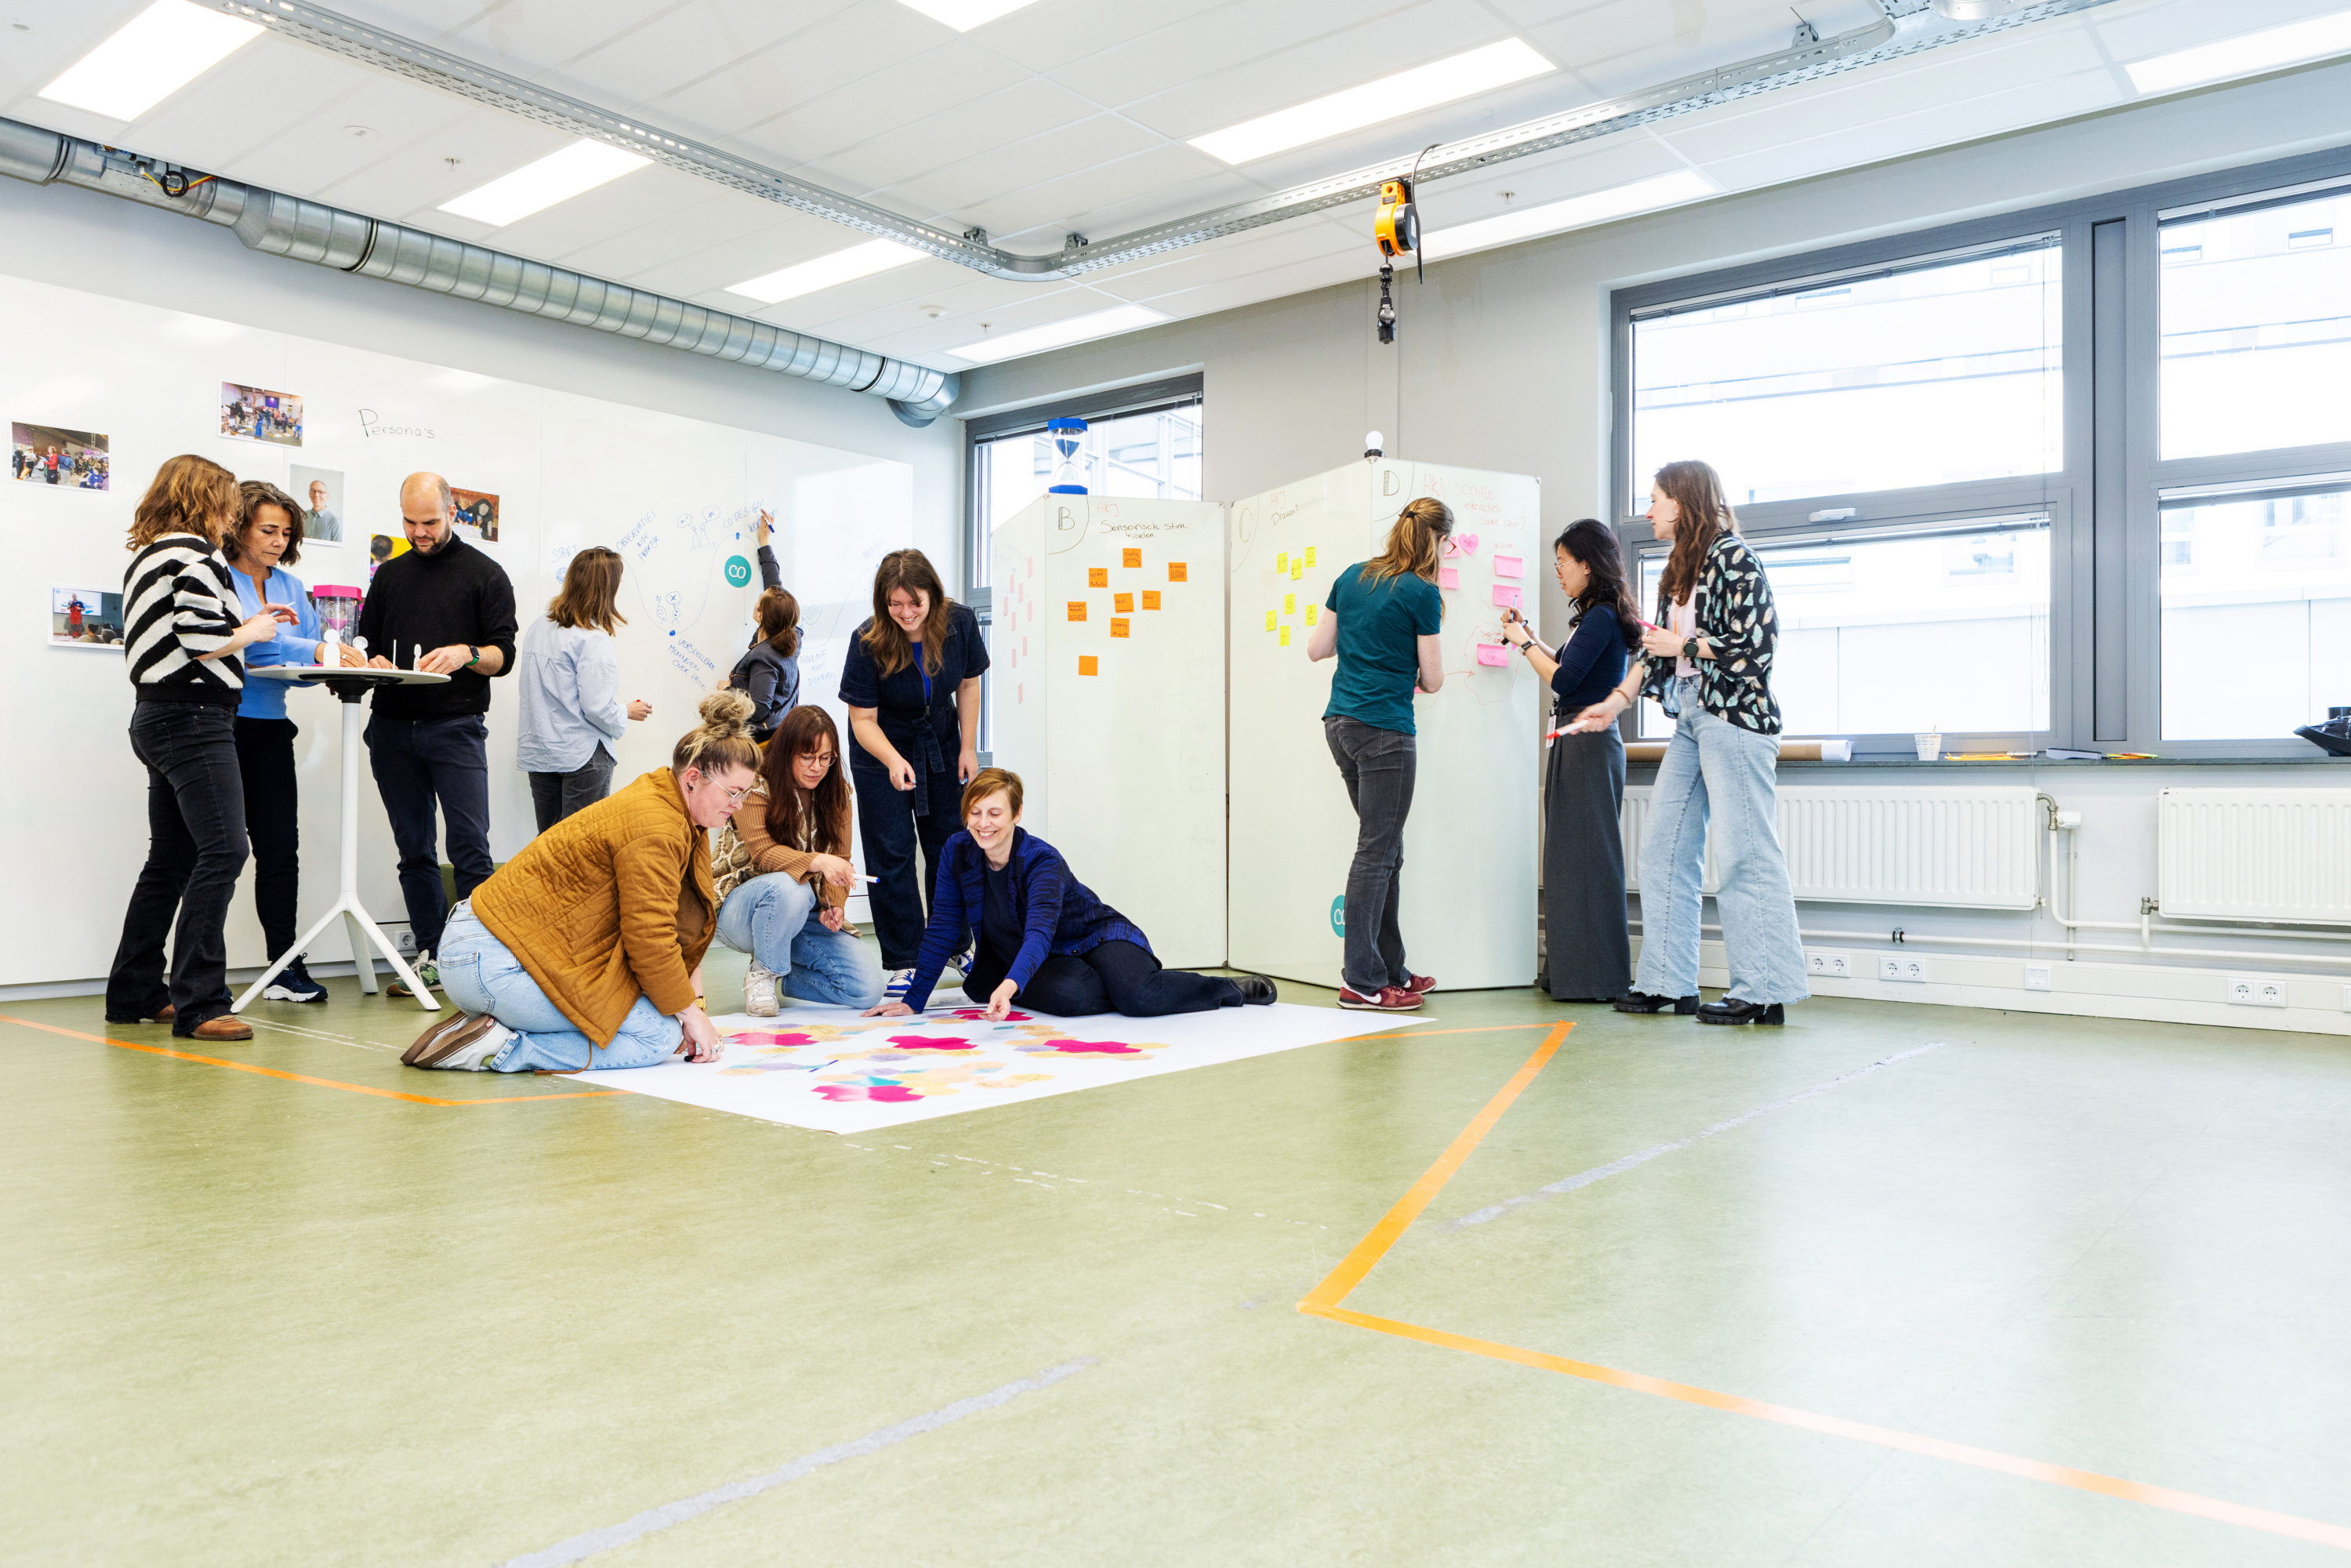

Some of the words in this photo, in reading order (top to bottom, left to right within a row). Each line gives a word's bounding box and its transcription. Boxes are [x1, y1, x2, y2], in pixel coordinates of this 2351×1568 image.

[357, 408, 436, 439] Persona's
[1383, 470, 1400, 496] D
[1058, 506, 1076, 531] B
[1100, 519, 1159, 534] Sensorisch
[1239, 507, 1253, 543] C
[551, 543, 578, 564] START
